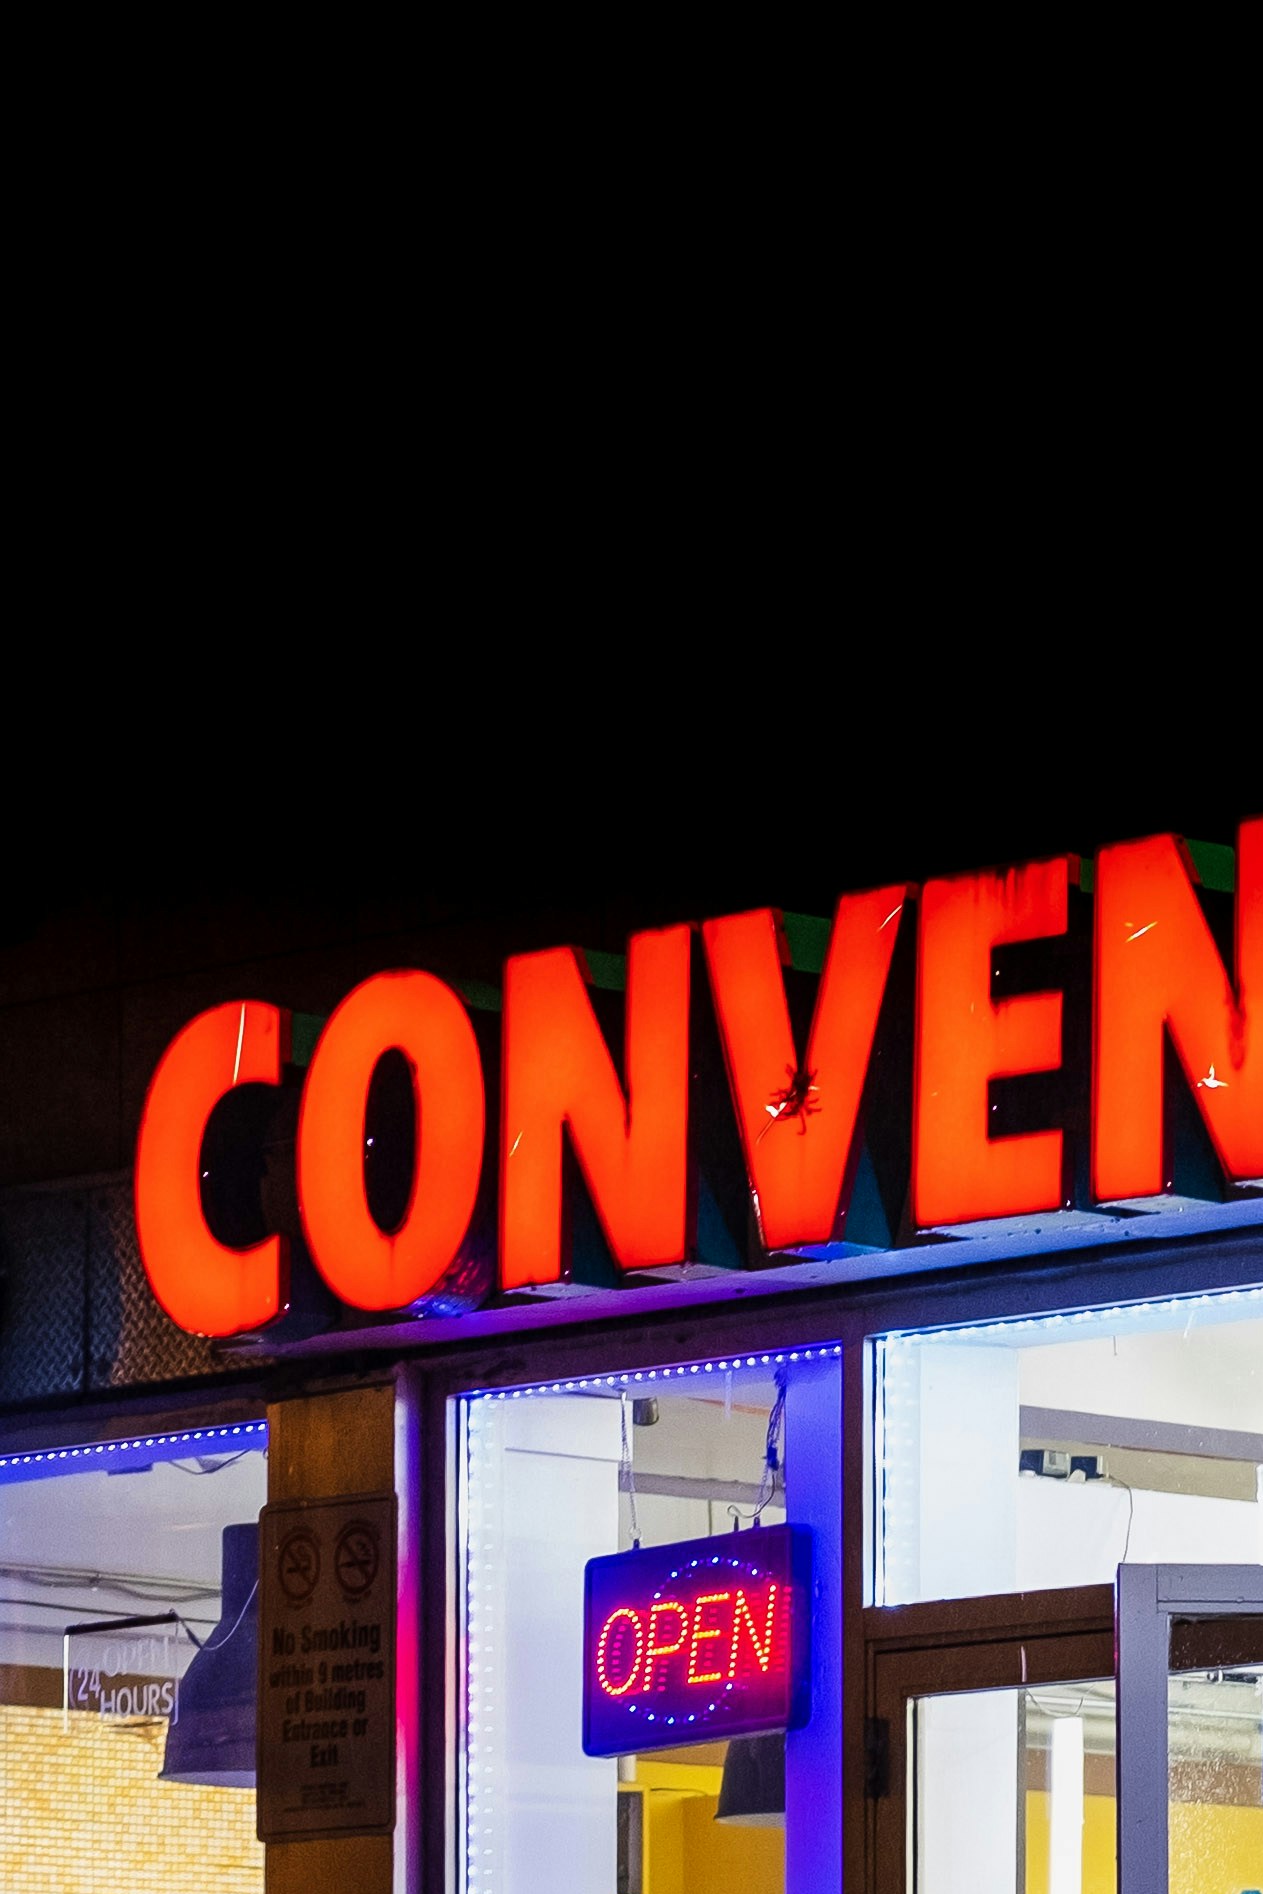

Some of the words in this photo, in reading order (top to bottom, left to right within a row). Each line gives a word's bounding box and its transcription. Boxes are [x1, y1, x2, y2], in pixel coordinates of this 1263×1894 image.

[273, 1628, 295, 1654] No
[302, 1621, 381, 1652] Smoking
[596, 1584, 777, 1696] OPEN
[319, 1662, 327, 1684] 9
[332, 1659, 384, 1681] metres
[101, 1681, 173, 1717] HOURS
[305, 1687, 366, 1713] Building
[283, 1719, 347, 1743] Entrance
[310, 1745, 338, 1768] Exit
